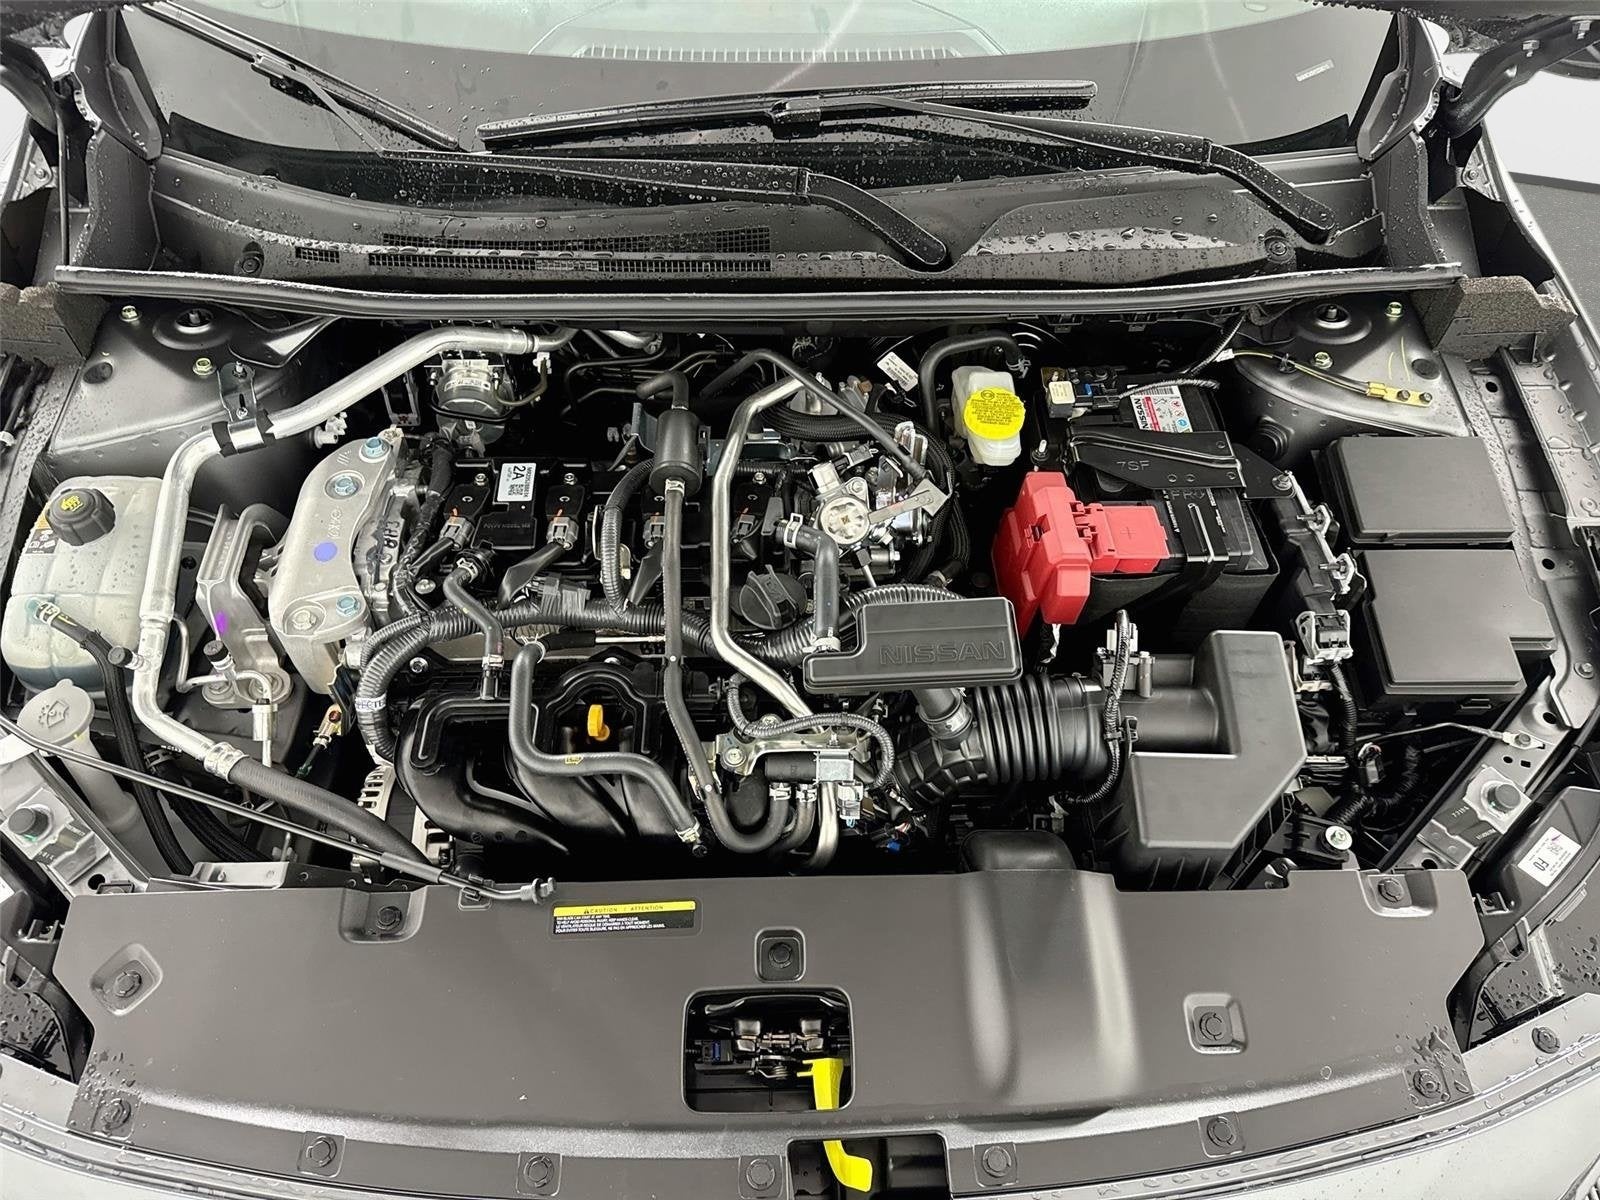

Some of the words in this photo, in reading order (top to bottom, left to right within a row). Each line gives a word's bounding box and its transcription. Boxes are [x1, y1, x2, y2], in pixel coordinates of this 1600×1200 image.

[1134, 398, 1149, 429] NISSAN
[512, 465, 527, 480] 2A
[880, 640, 1007, 664] NISSAN
